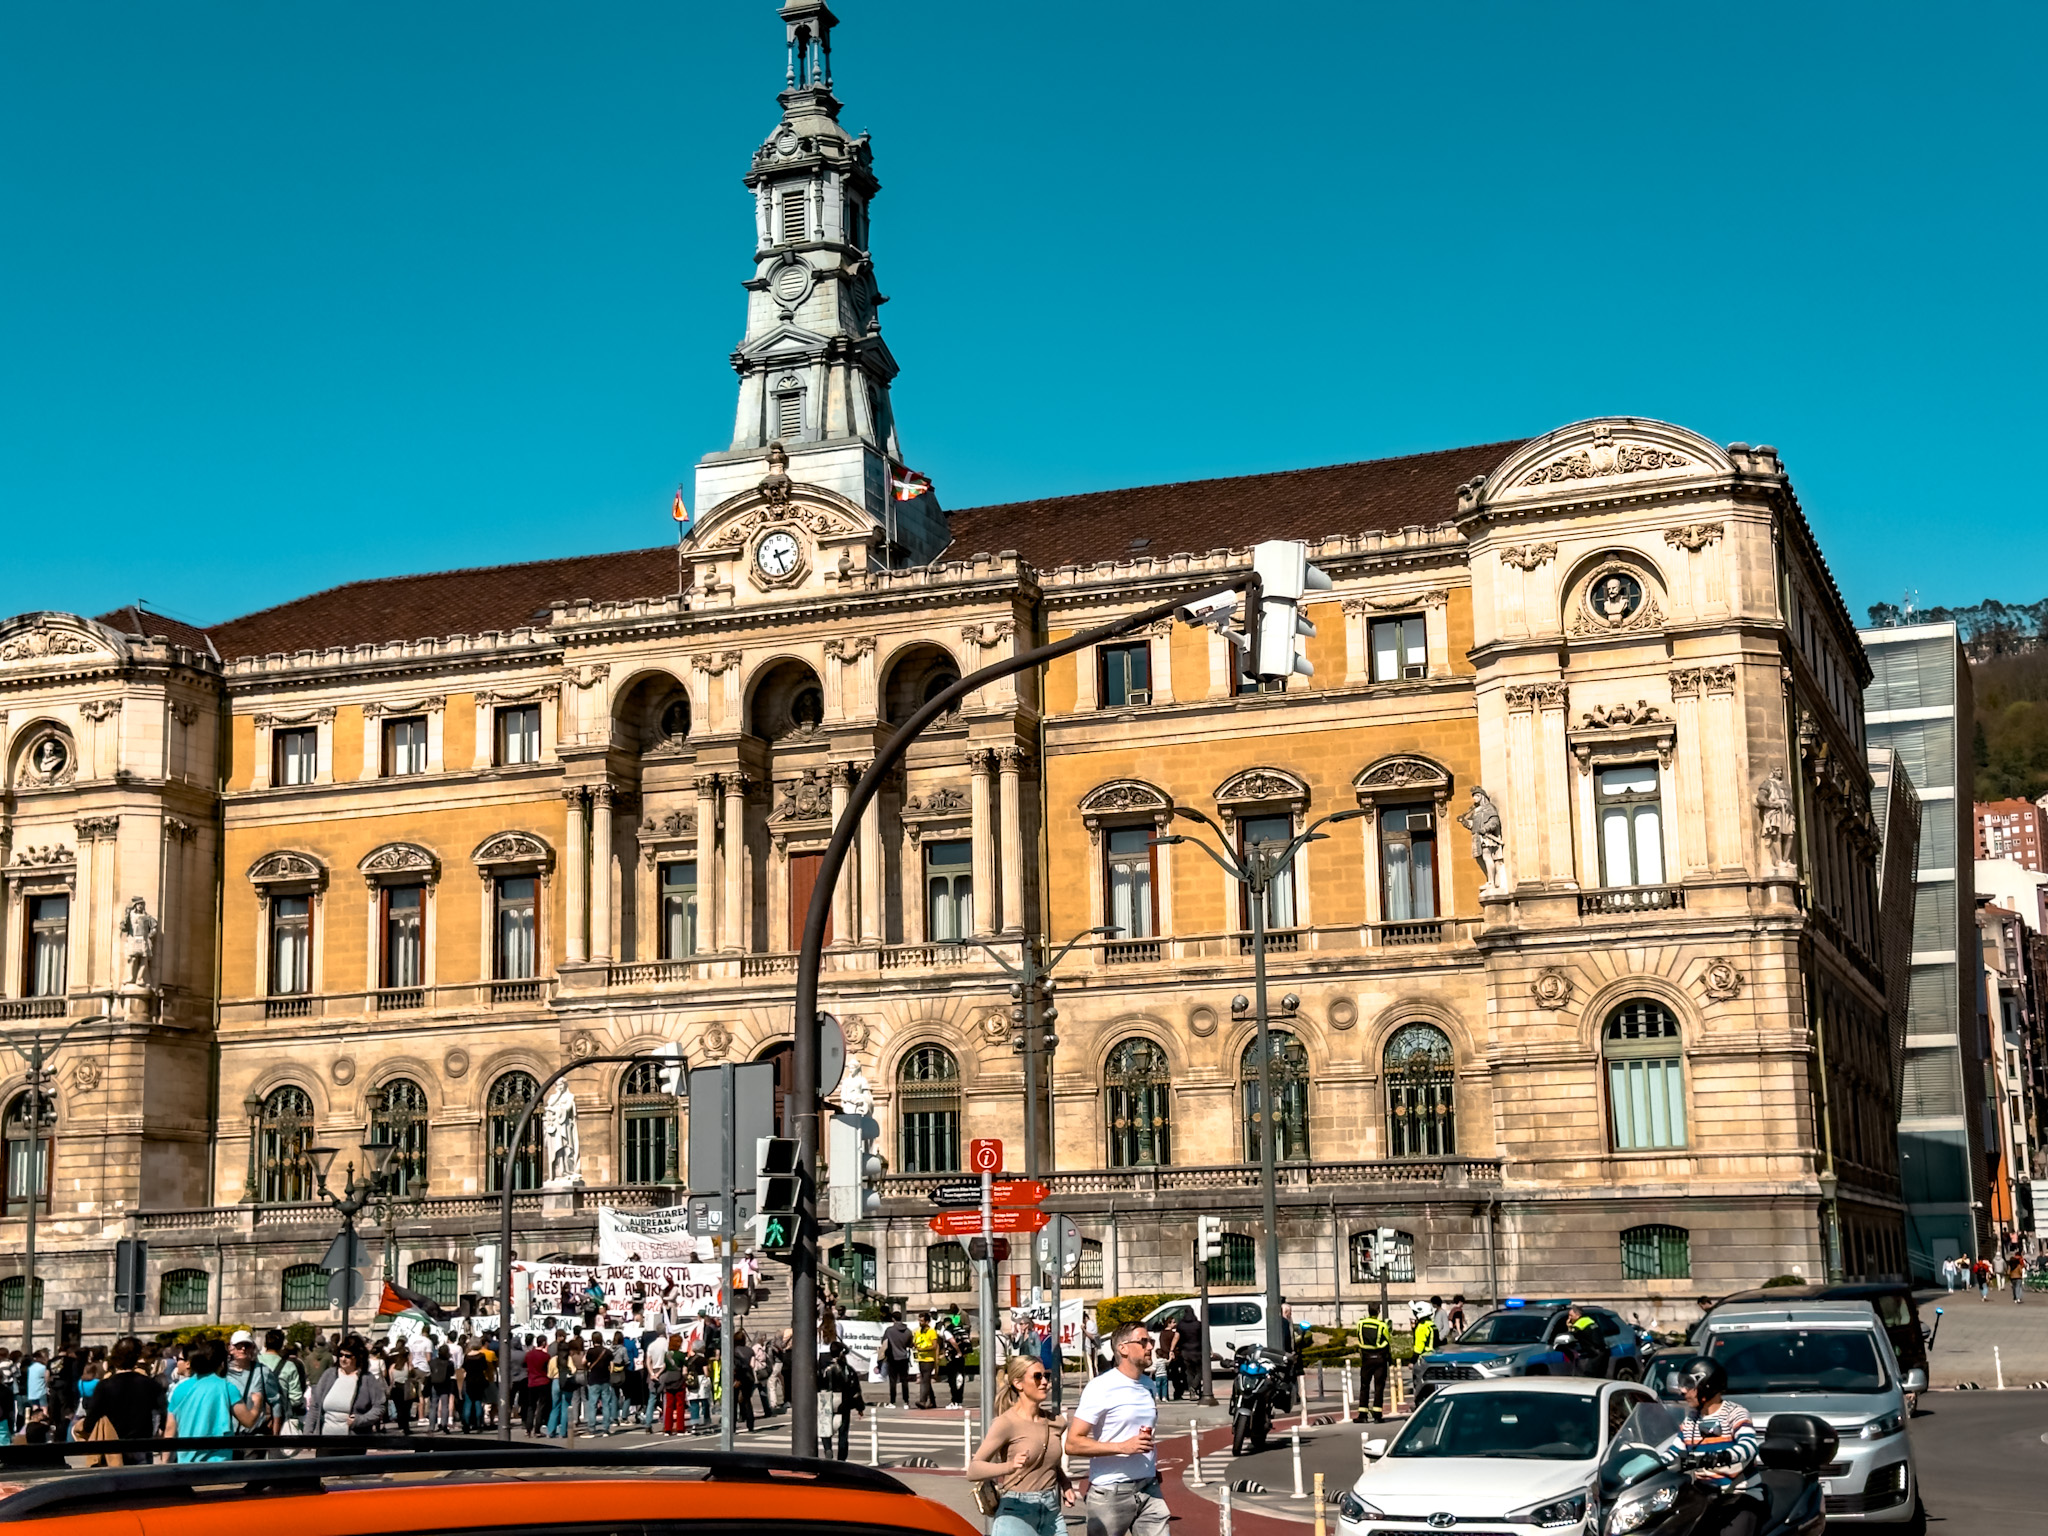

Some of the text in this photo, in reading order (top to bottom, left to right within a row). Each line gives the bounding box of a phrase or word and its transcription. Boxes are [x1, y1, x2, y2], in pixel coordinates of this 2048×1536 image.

[984, 1151, 990, 1165] i
[619, 1242, 636, 1250] NTE
[639, 1242, 648, 1250] EL
[652, 1251, 663, 1259] DE
[666, 1248, 695, 1258] CLAS
[550, 1265, 691, 1281] ANTE EL AUGE RACISTA
